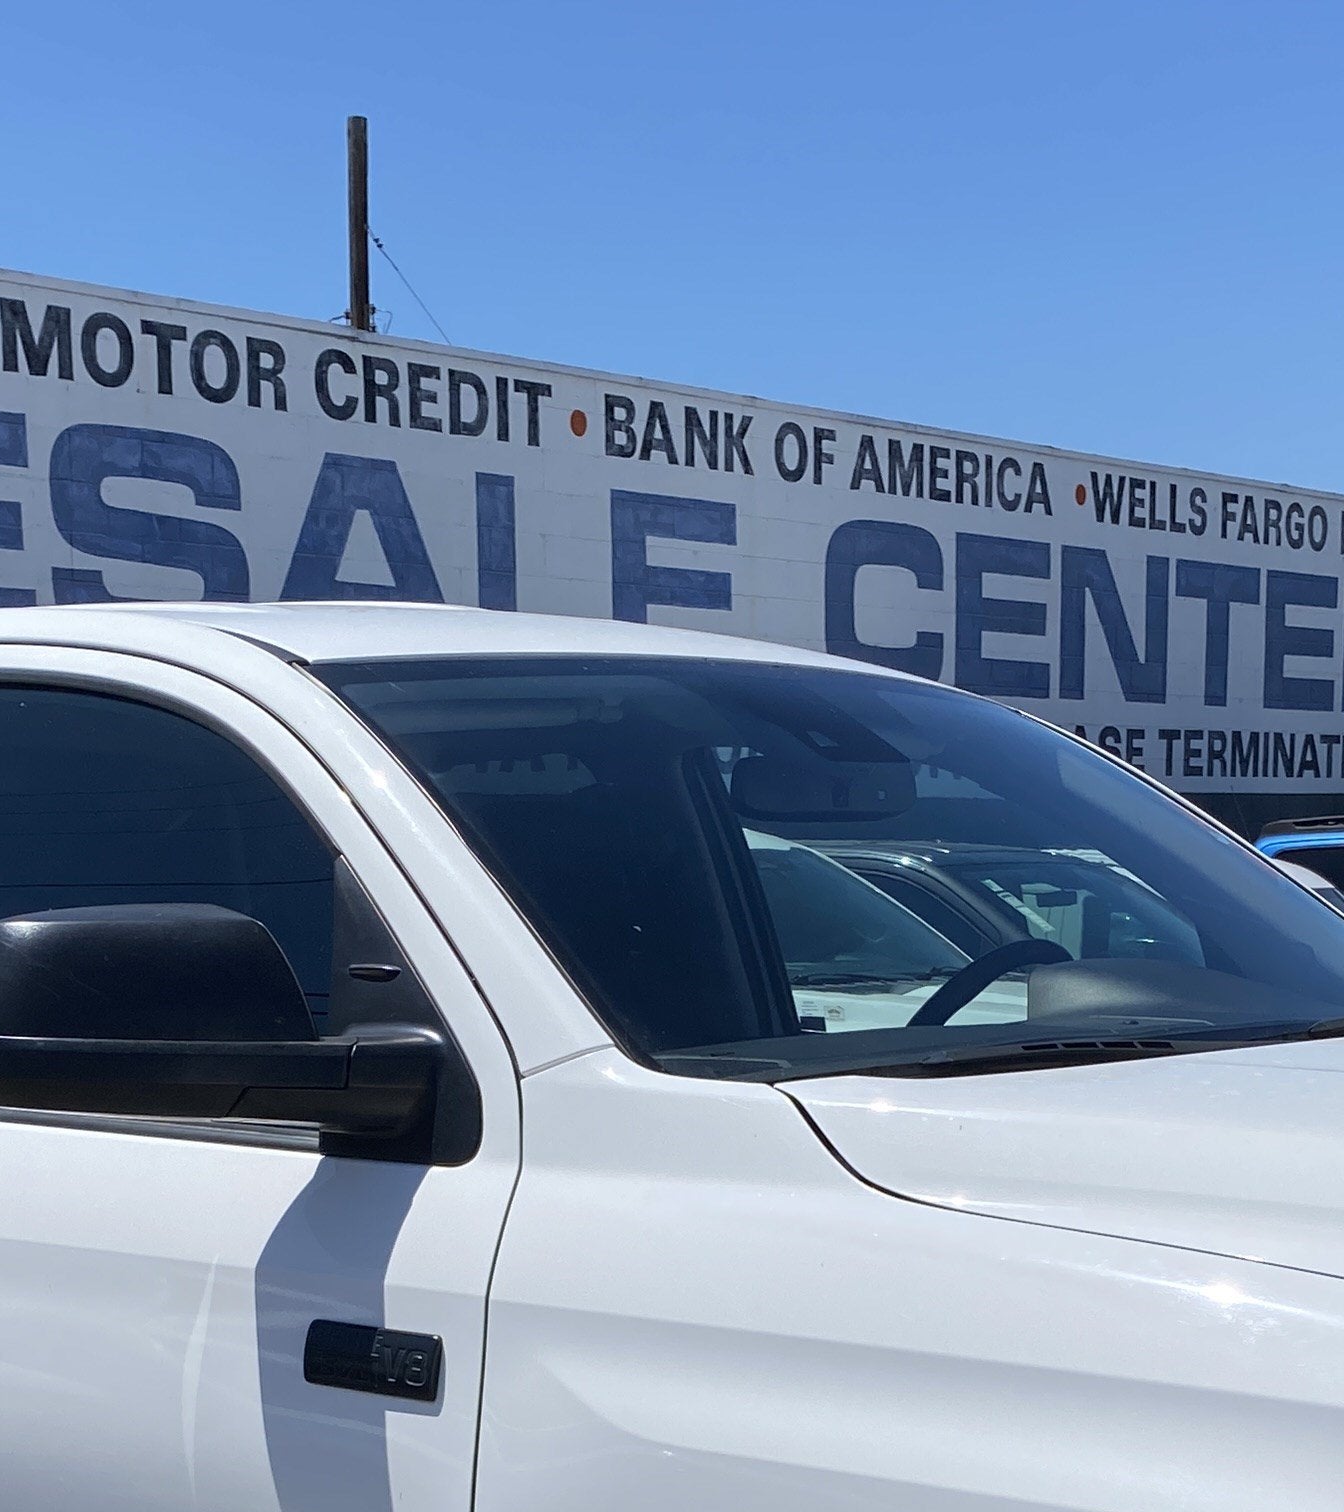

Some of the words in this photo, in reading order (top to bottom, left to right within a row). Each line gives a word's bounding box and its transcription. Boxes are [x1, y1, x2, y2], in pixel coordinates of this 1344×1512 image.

[0, 296, 288, 411] MOTOR
[314, 348, 552, 447] CREDIT
[603, 392, 754, 476] BANK
[775, 422, 838, 485] OF
[850, 434, 1054, 516] AMERICA
[1090, 471, 1208, 538] WELLS
[1221, 493, 1328, 553] FARGO
